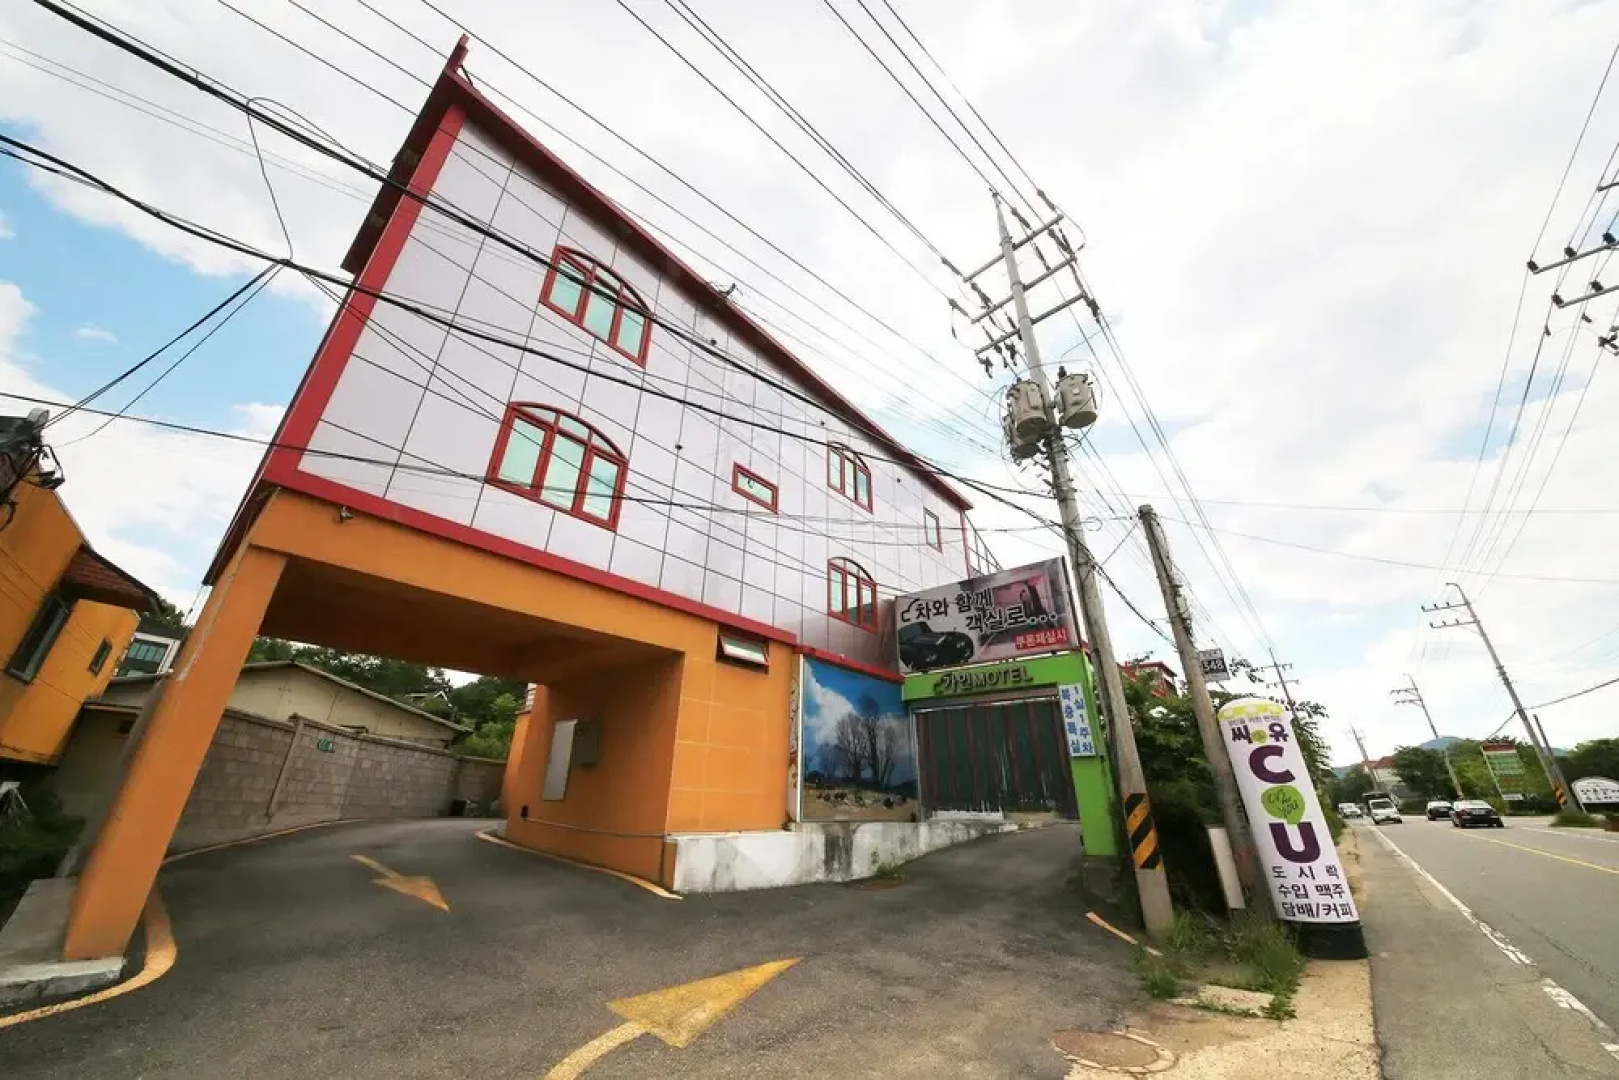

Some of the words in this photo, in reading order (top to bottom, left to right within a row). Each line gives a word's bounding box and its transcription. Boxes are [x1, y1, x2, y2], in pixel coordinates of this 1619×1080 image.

[915, 597, 949, 621] 차와
[955, 587, 993, 614] 함께
[1279, 884, 1309, 899] 수입
[1315, 883, 1345, 899] 맥주
